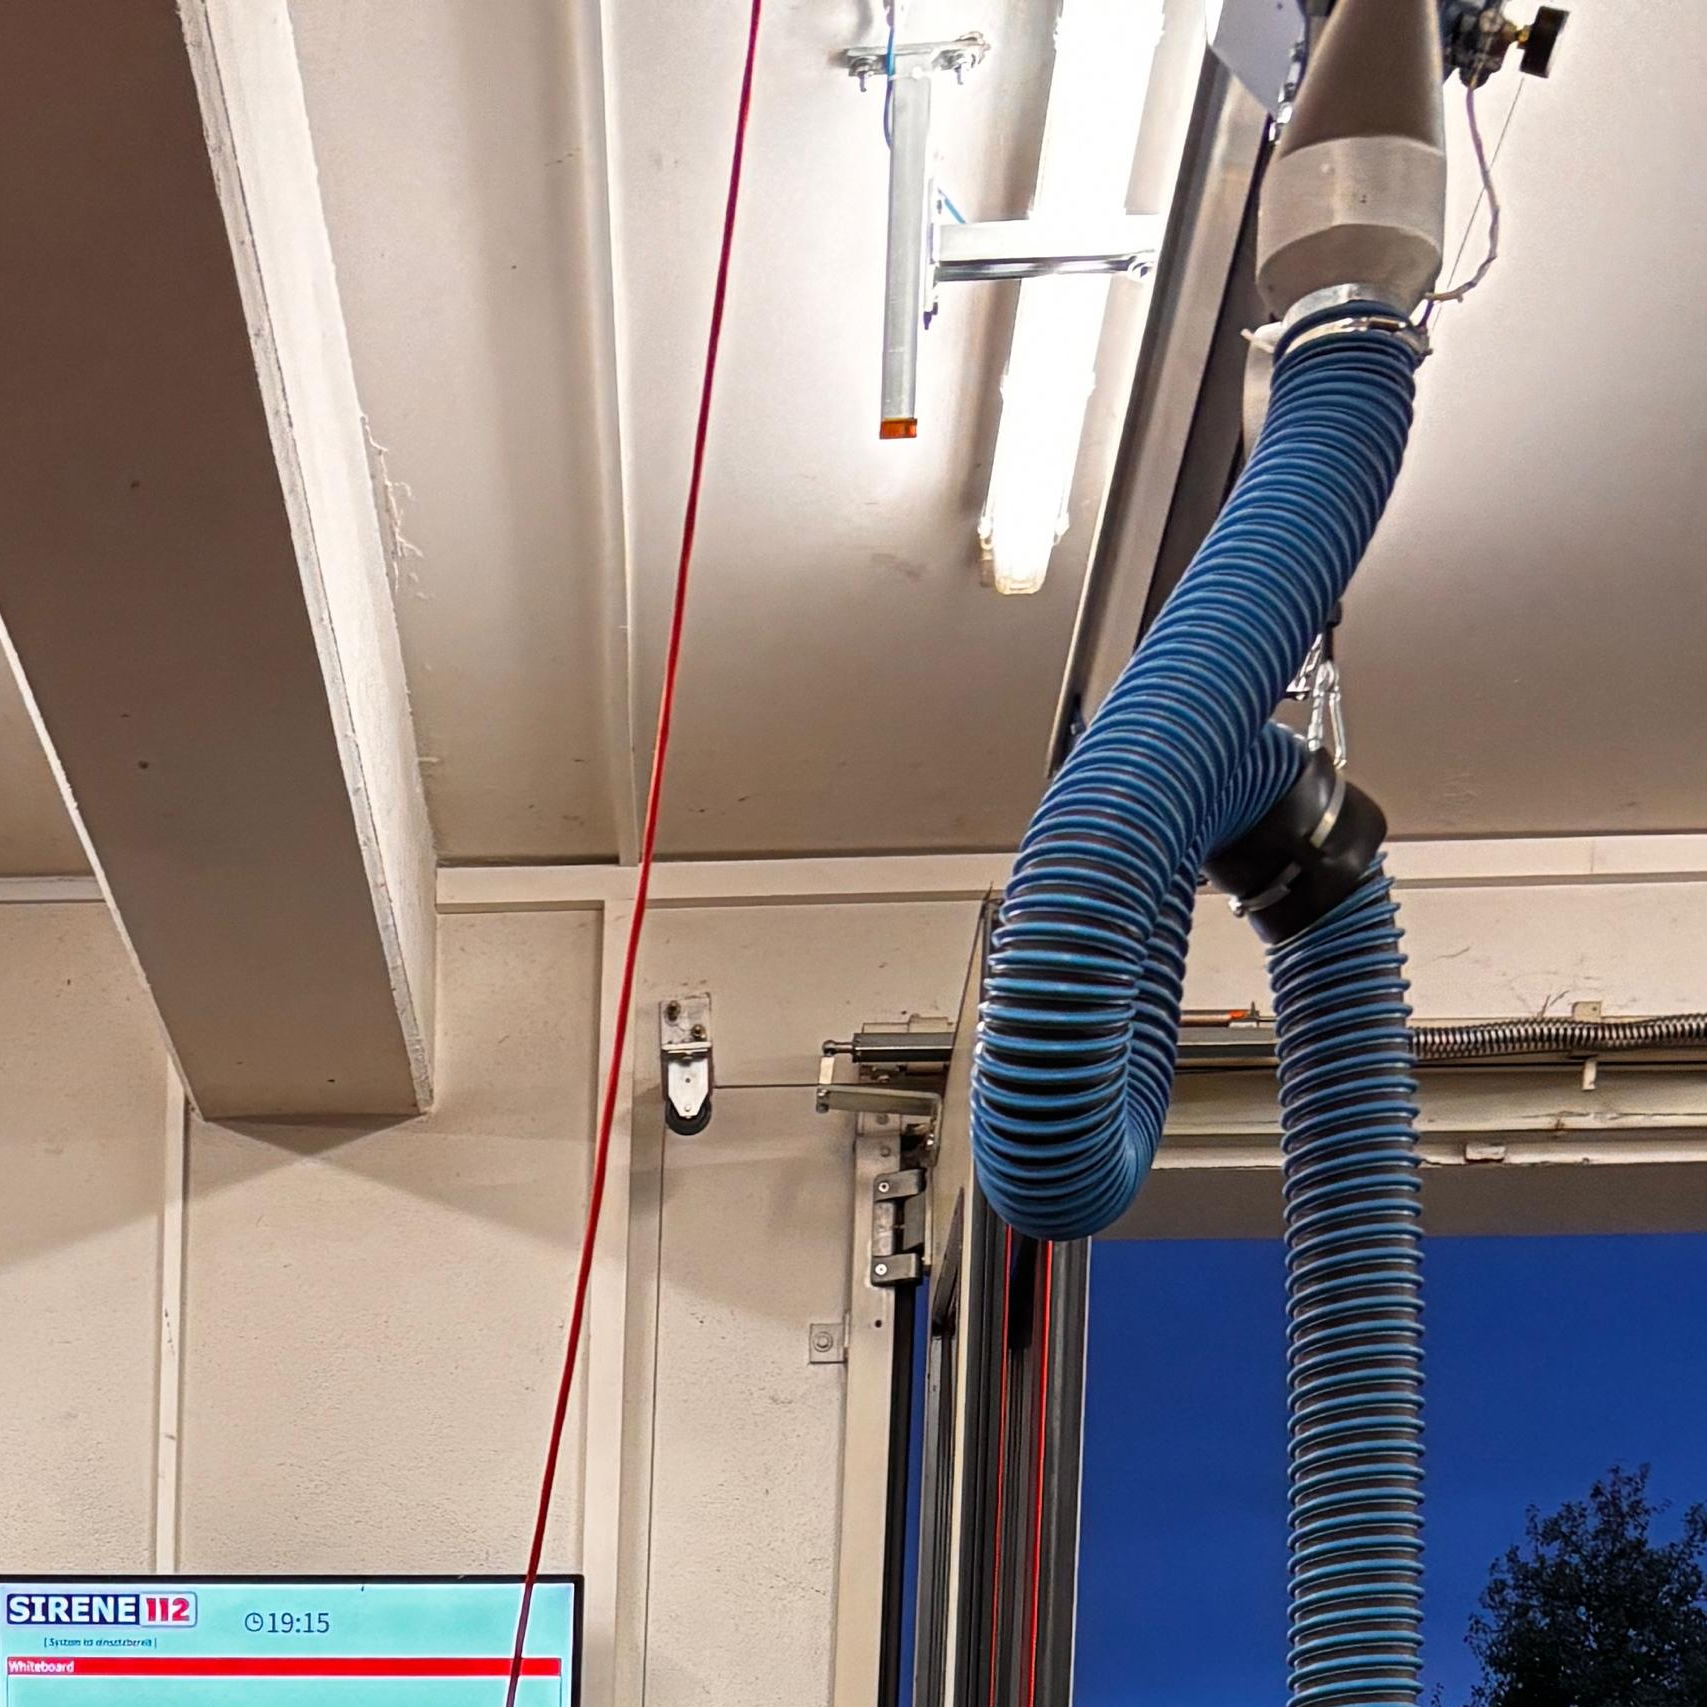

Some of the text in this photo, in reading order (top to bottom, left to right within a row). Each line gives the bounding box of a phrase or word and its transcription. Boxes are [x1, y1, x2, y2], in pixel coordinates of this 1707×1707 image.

[8, 1596, 190, 1623] SIRENE 112
[267, 1612, 330, 1634] 19:15
[8, 1660, 75, 1673] Whiteboard
